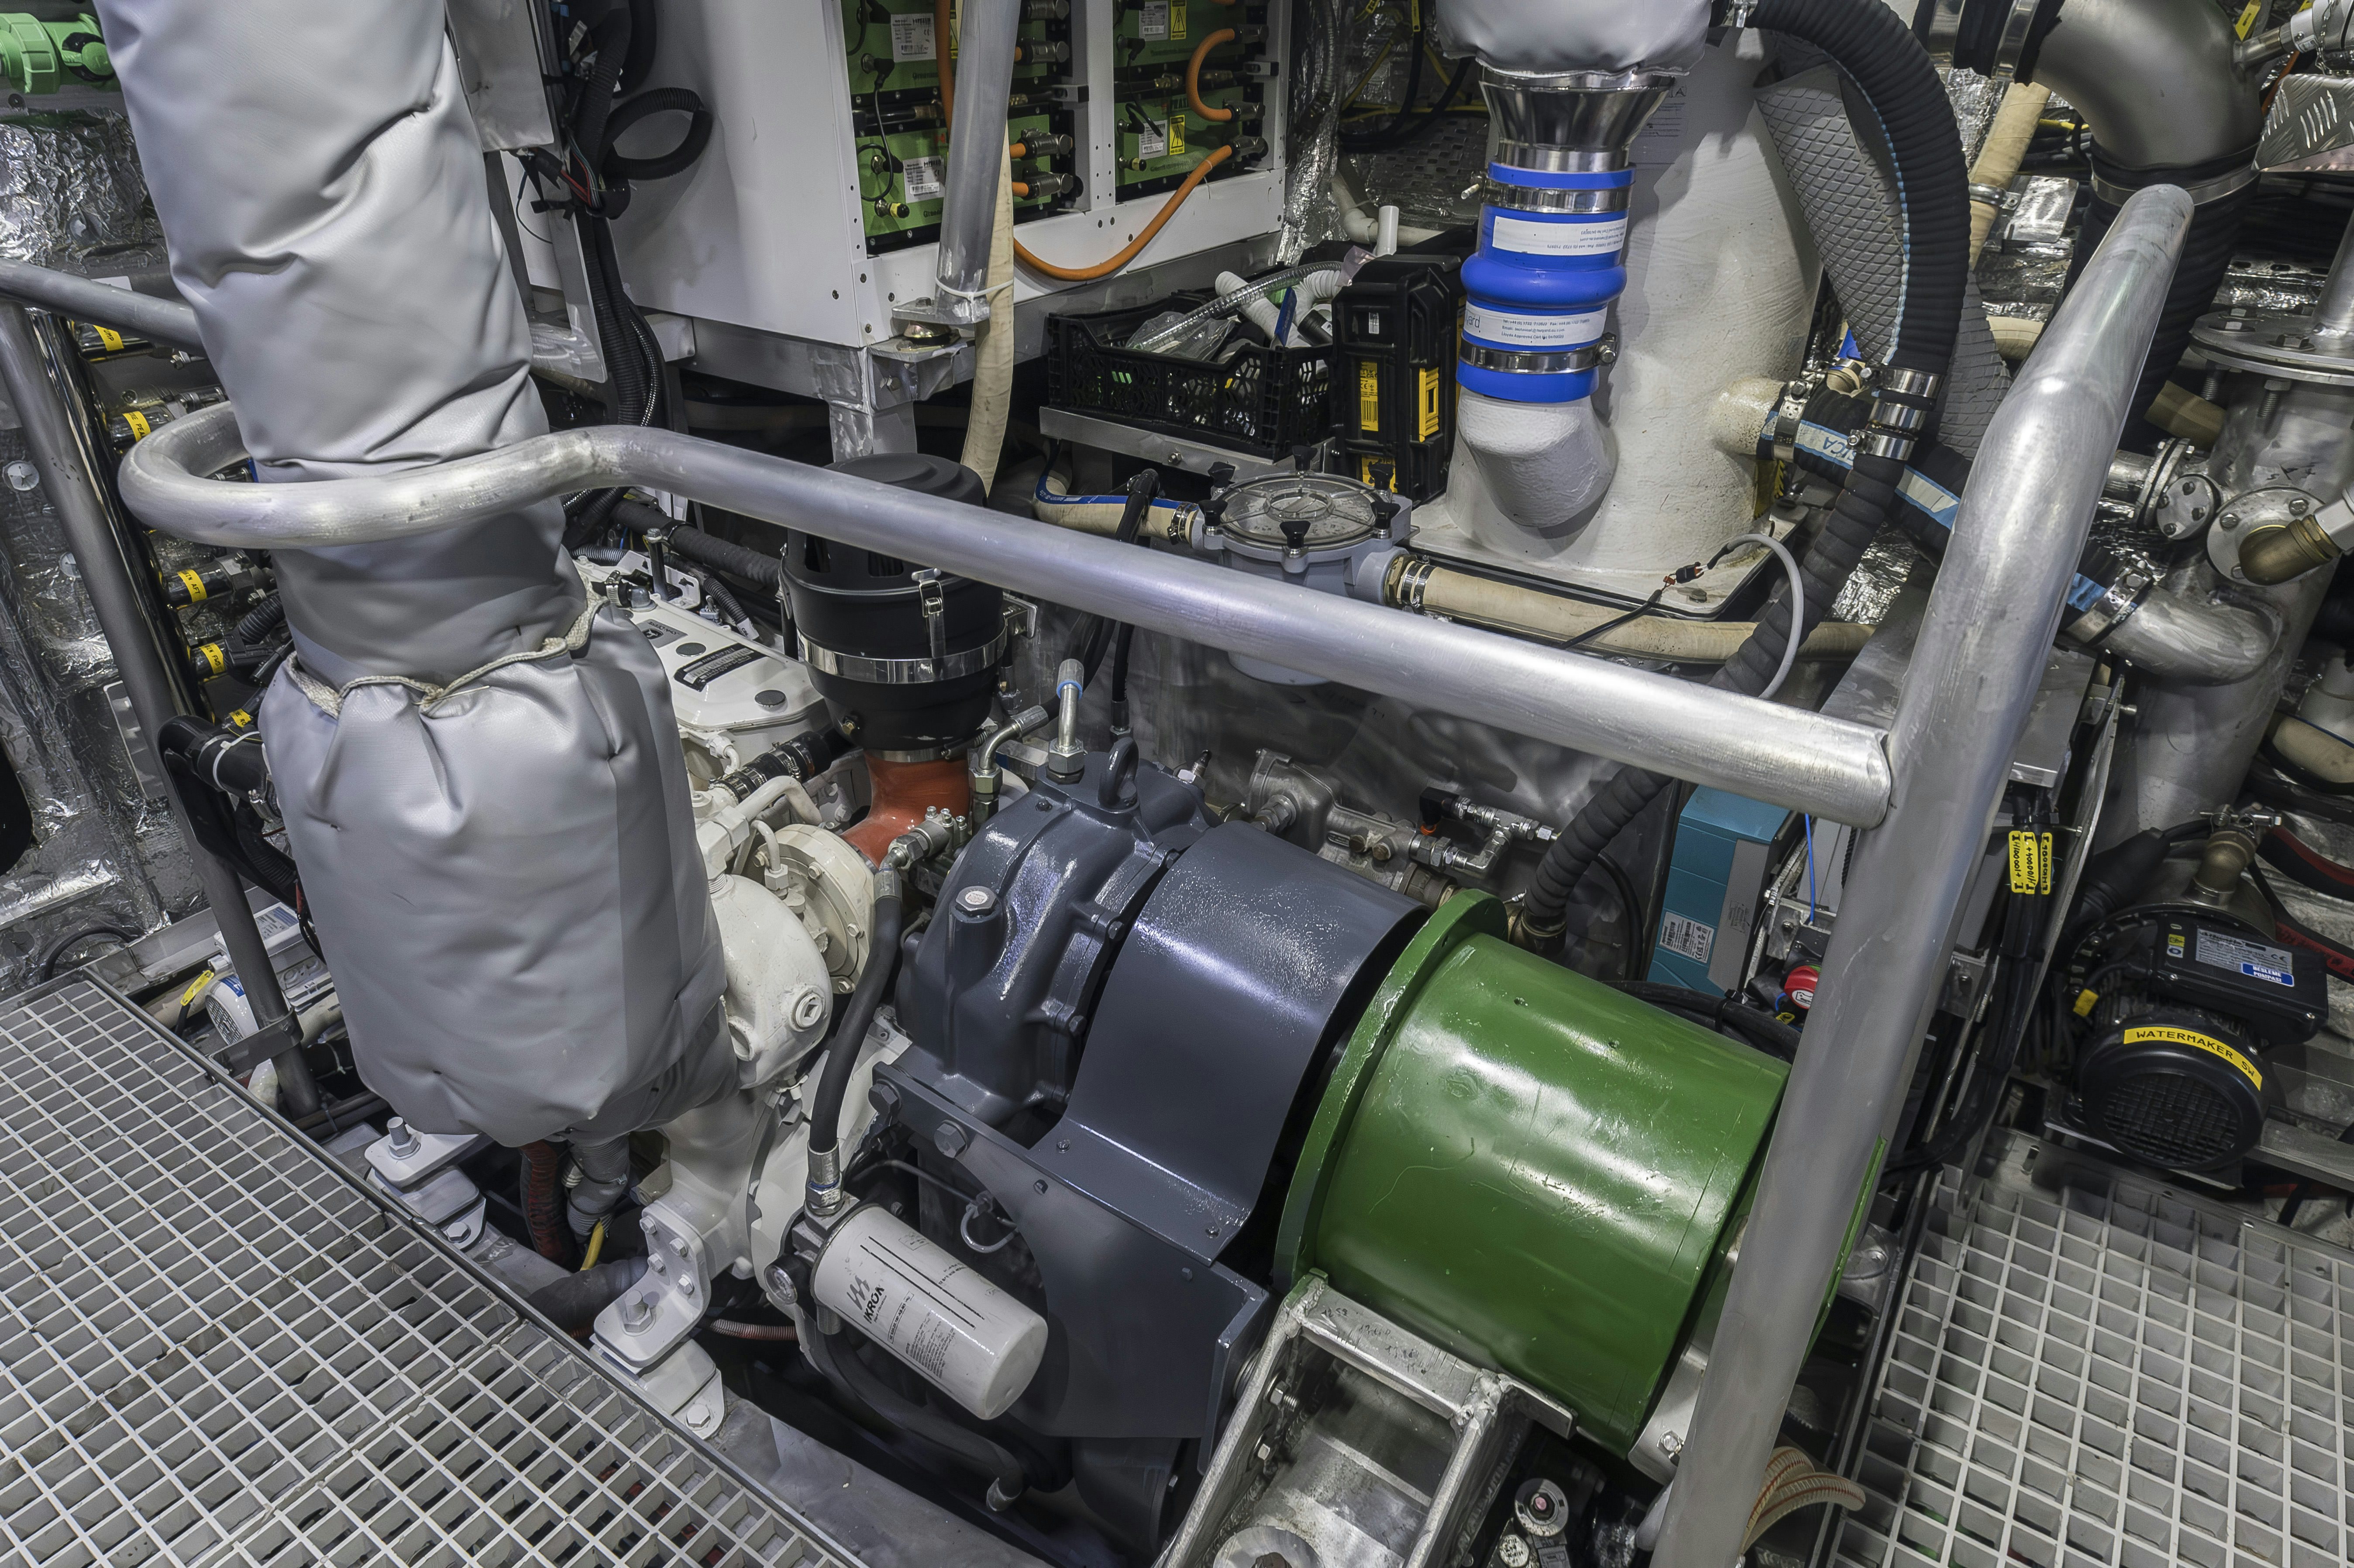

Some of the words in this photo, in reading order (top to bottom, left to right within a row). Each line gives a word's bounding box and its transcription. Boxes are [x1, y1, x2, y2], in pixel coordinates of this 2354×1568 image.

[191, 584, 200, 594] AFT
[212, 655, 221, 666] FWD
[2136, 1030, 2233, 1060] WATERMAKER
[2241, 1060, 2255, 1077] SW
